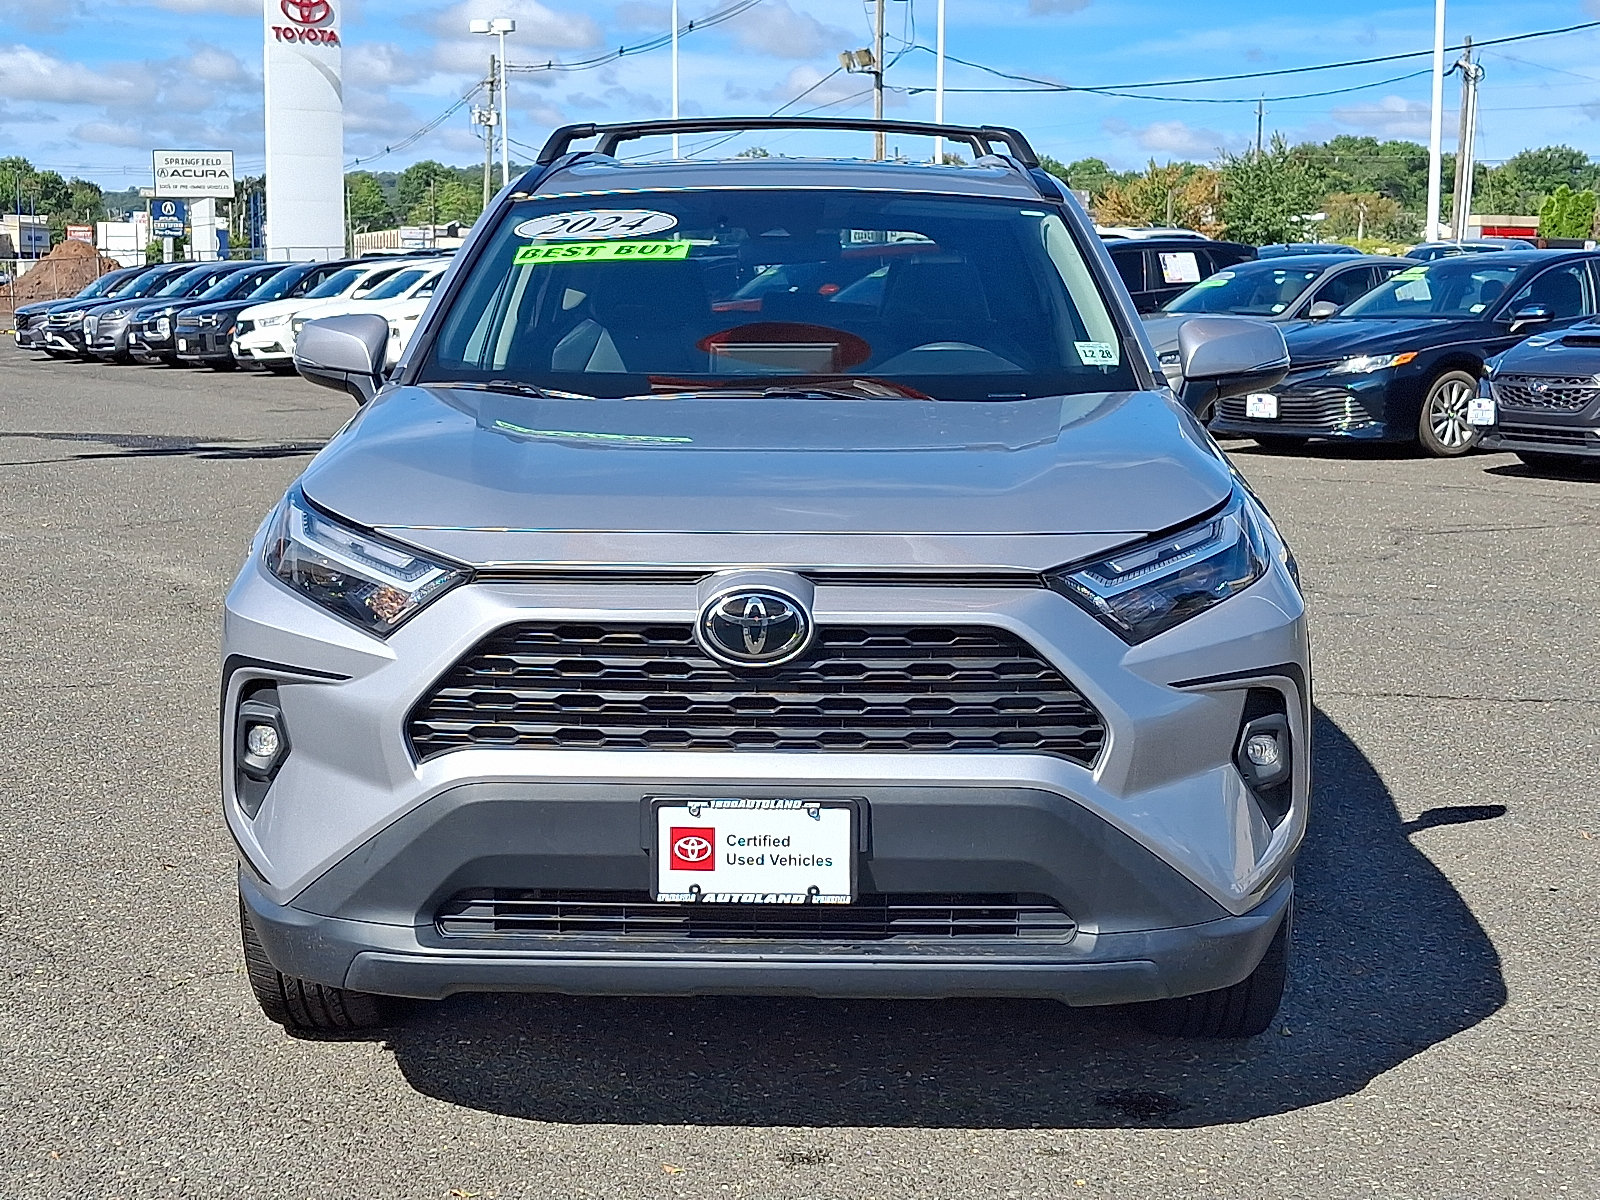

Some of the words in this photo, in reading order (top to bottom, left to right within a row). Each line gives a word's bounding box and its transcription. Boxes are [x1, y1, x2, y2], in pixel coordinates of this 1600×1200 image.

[272, 26, 340, 45] TOYOTA
[164, 157, 222, 166] SPRINGFIELD
[170, 169, 230, 178] ACURA
[536, 214, 656, 235] 2024
[518, 245, 606, 260] BEST
[613, 243, 685, 256] BUY
[1082, 349, 1097, 358] 12
[1099, 349, 1113, 359] 28
[726, 834, 791, 848] Certified
[726, 853, 765, 866] Used
[769, 854, 833, 867] Vehicles
[701, 893, 807, 904] AUTOLAND
